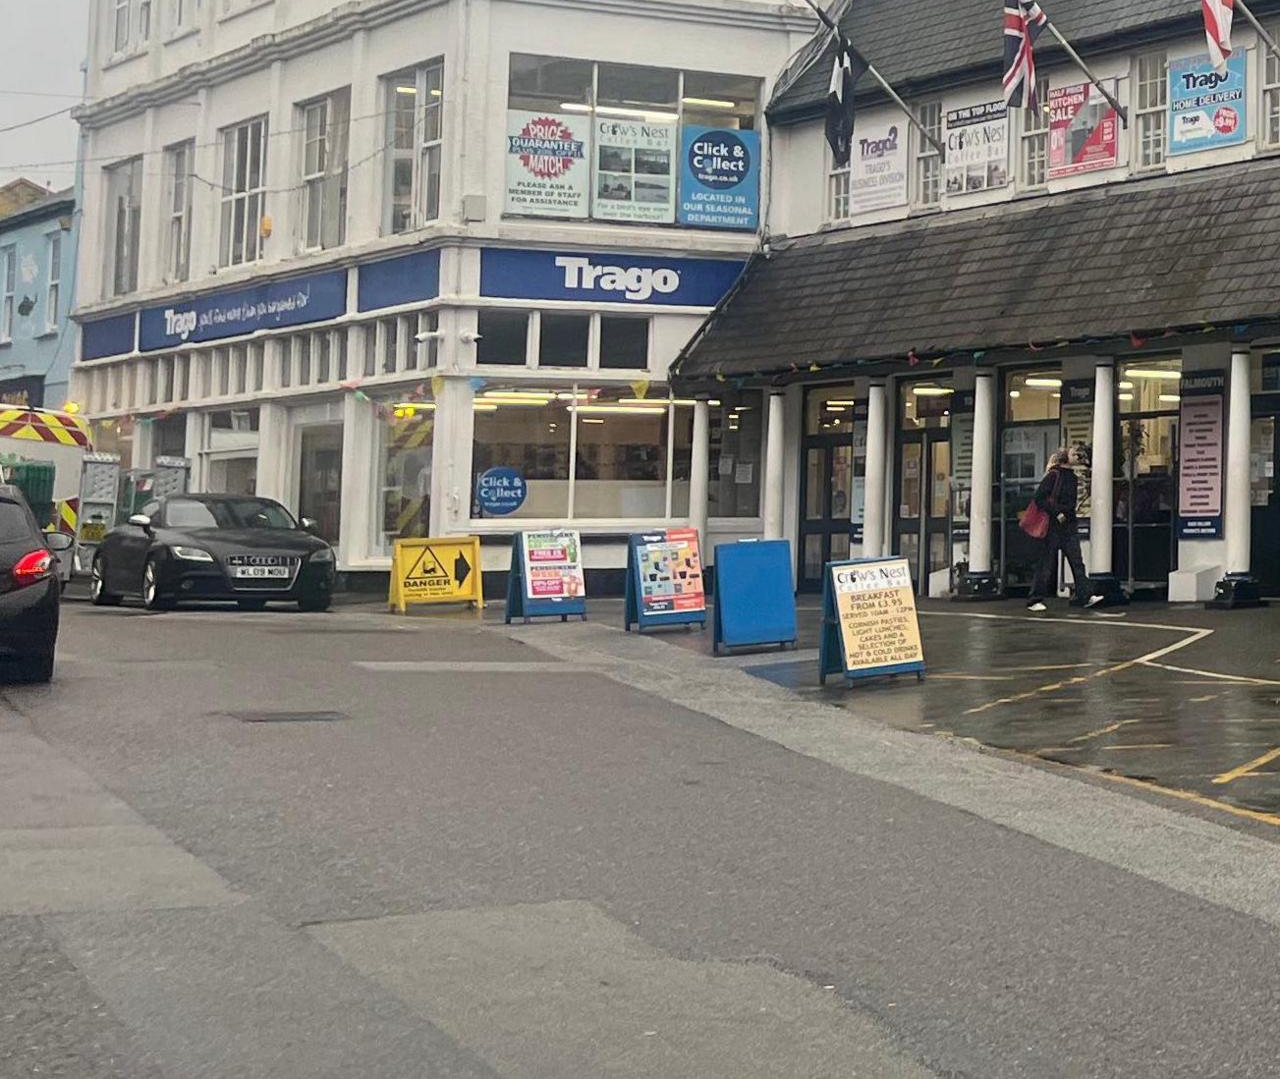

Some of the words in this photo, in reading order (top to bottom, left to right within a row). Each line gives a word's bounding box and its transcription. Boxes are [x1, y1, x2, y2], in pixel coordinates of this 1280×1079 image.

[1049, 93, 1085, 109] KITCHEN
[1172, 97, 1199, 111] HOME
[1199, 89, 1242, 106] DELIVERY
[948, 112, 958, 122] ON
[959, 109, 971, 119] THE
[972, 106, 985, 116] TOP
[1050, 106, 1075, 123] SALE
[1182, 115, 1200, 125] Trago
[528, 124, 566, 140] PRICE
[641, 126, 668, 137] Nest
[983, 124, 1005, 145] Nest
[693, 142, 729, 157] Click
[733, 145, 744, 158] &
[528, 154, 563, 174] MATCH
[517, 181, 547, 189] PLEASE
[508, 188, 543, 196] MEMBER
[557, 191, 582, 199] STAFF
[691, 192, 733, 203] LOCATED
[735, 196, 746, 204] IN
[529, 198, 579, 207] ASSISTANCE
[683, 202, 703, 212] OUR
[705, 204, 753, 216] SEASONAL
[687, 213, 749, 225] DEPARTMENT
[555, 256, 680, 300] Trago
[165, 309, 197, 340] Trago
[481, 477, 510, 487] Click
[513, 477, 522, 487] &
[879, 566, 906, 579] Nest
[403, 579, 452, 588] DANGER
[850, 589, 900, 602] BREAKFAST
[850, 601, 876, 611] FROM
[843, 611, 869, 620] SERVED
[848, 620, 880, 629] CORNISH
[851, 627, 874, 637] LIGHT
[859, 634, 882, 643] CAKES
[849, 651, 865, 659] HOT
[873, 647, 893, 657] COLD
[894, 643, 919, 653] DRINKS
[857, 640, 897, 651] SELECTION
[852, 655, 890, 666] AVAILABLE
[890, 653, 903, 662] ALL
[904, 651, 918, 660] DAY
